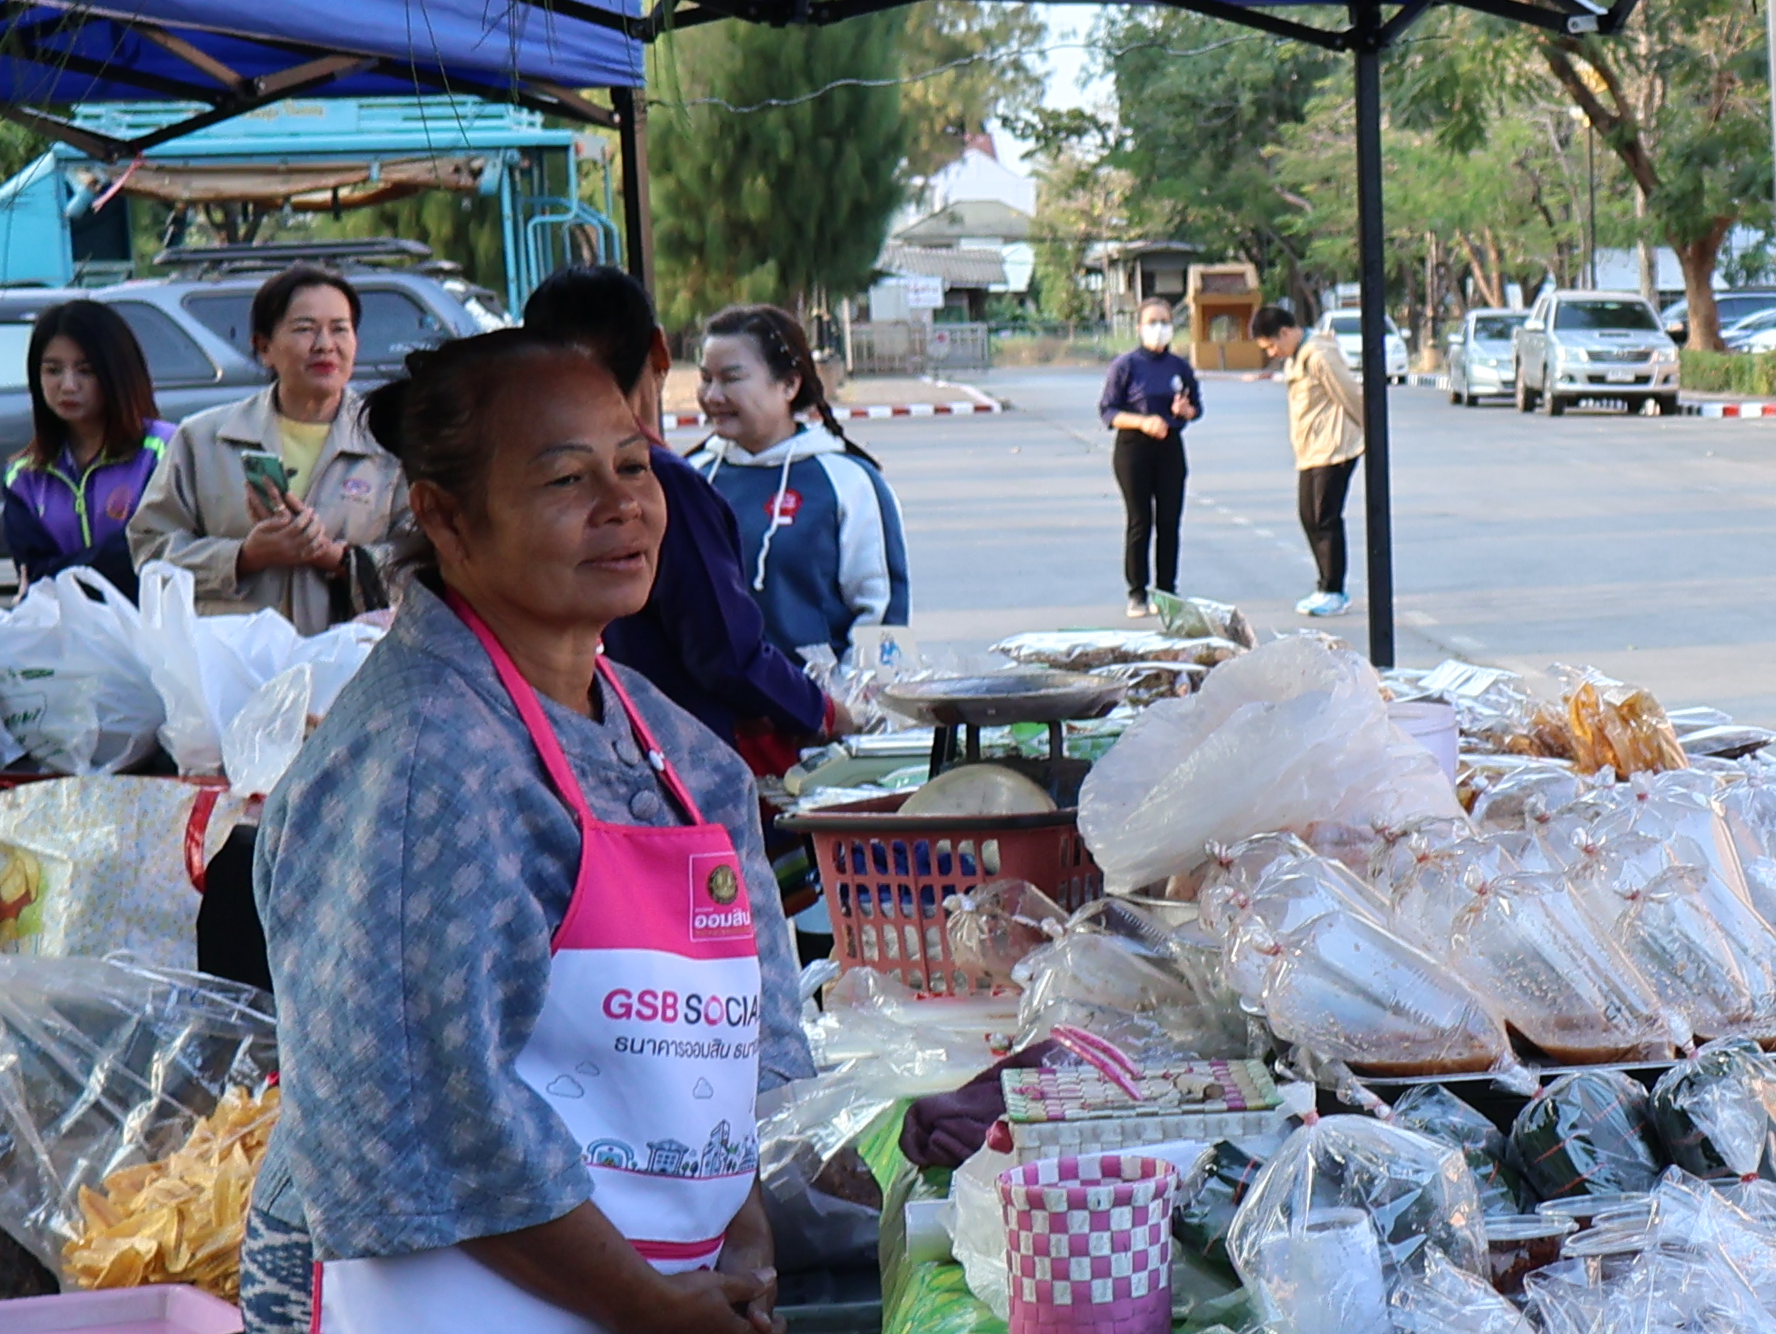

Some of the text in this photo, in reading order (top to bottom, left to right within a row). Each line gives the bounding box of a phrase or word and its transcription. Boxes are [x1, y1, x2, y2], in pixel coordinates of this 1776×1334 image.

[694, 908, 752, 930] ออมสิน
[602, 988, 760, 1028] GSB SOCIA
[614, 1034, 730, 1059] ธนาคารออมสิน
